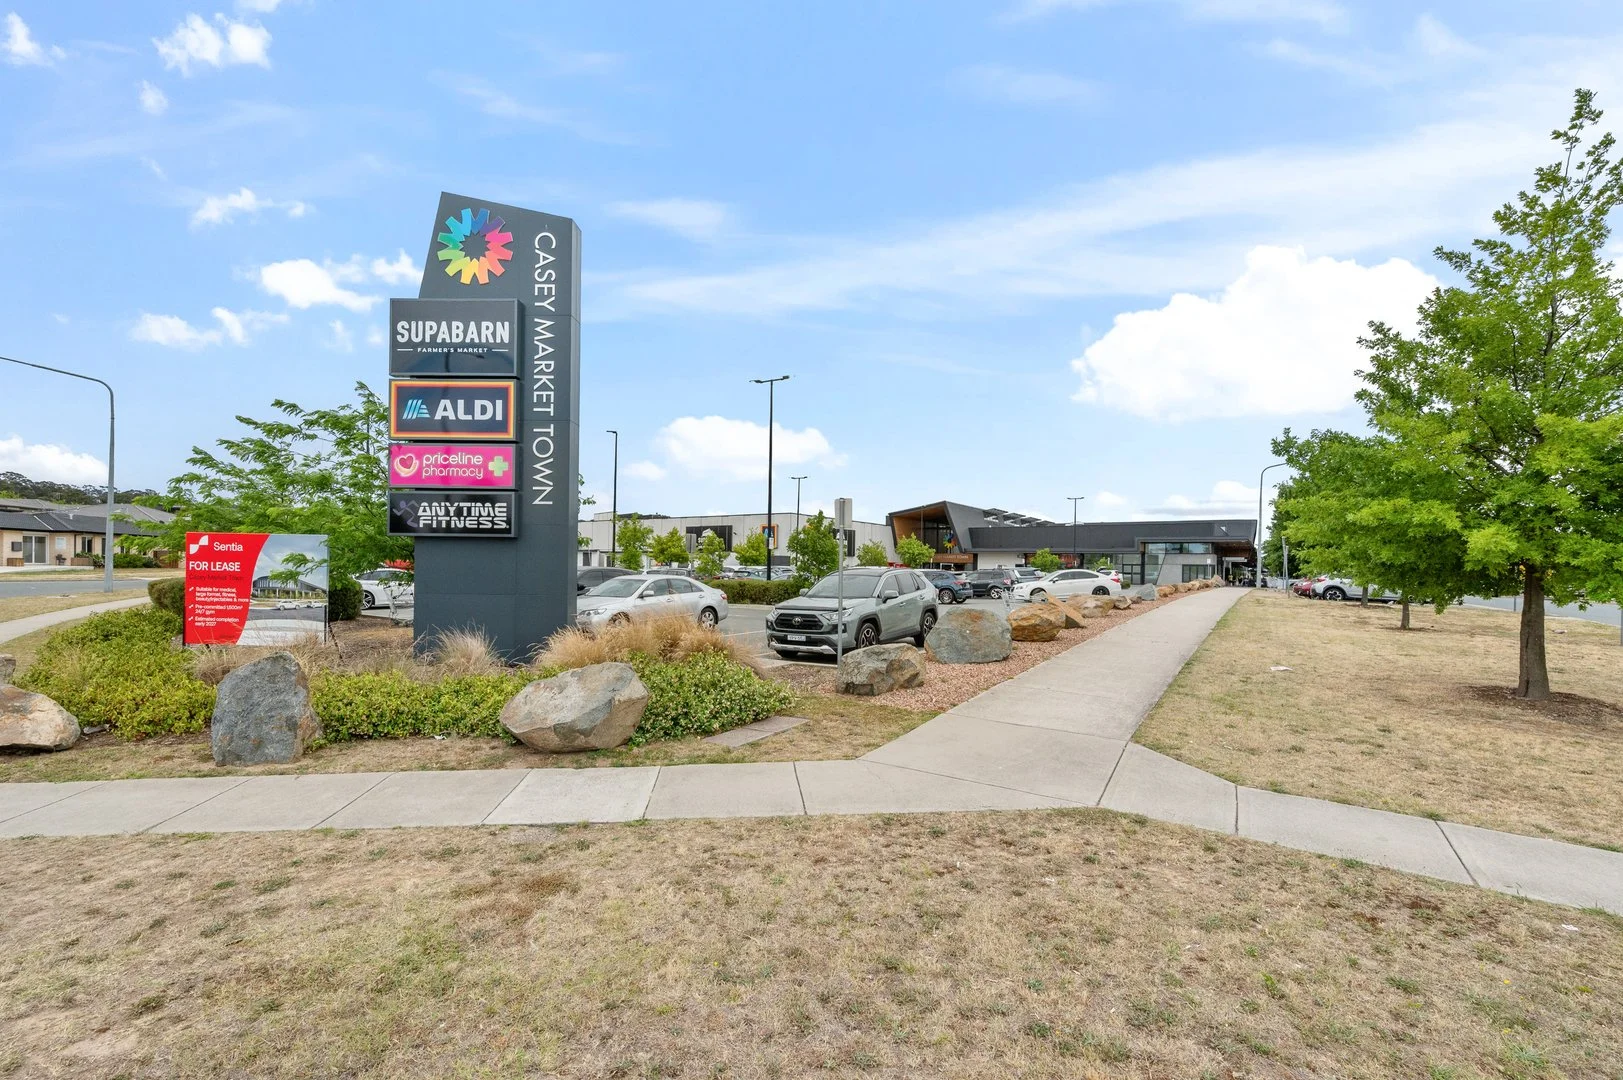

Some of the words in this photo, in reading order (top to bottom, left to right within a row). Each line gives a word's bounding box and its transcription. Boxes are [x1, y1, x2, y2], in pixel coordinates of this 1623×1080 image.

[534, 231, 556, 312] CASEY
[396, 320, 510, 343] SUPABARN
[533, 317, 555, 416] MARKET
[434, 399, 503, 421] ALDI
[422, 452, 483, 467] priceline
[531, 423, 554, 505] TOWN
[422, 465, 484, 480] pharmacy
[417, 501, 508, 517] ANYTIME
[213, 541, 243, 552] Sentia
[189, 561, 209, 571] FOR
[210, 562, 240, 572] LEASE
